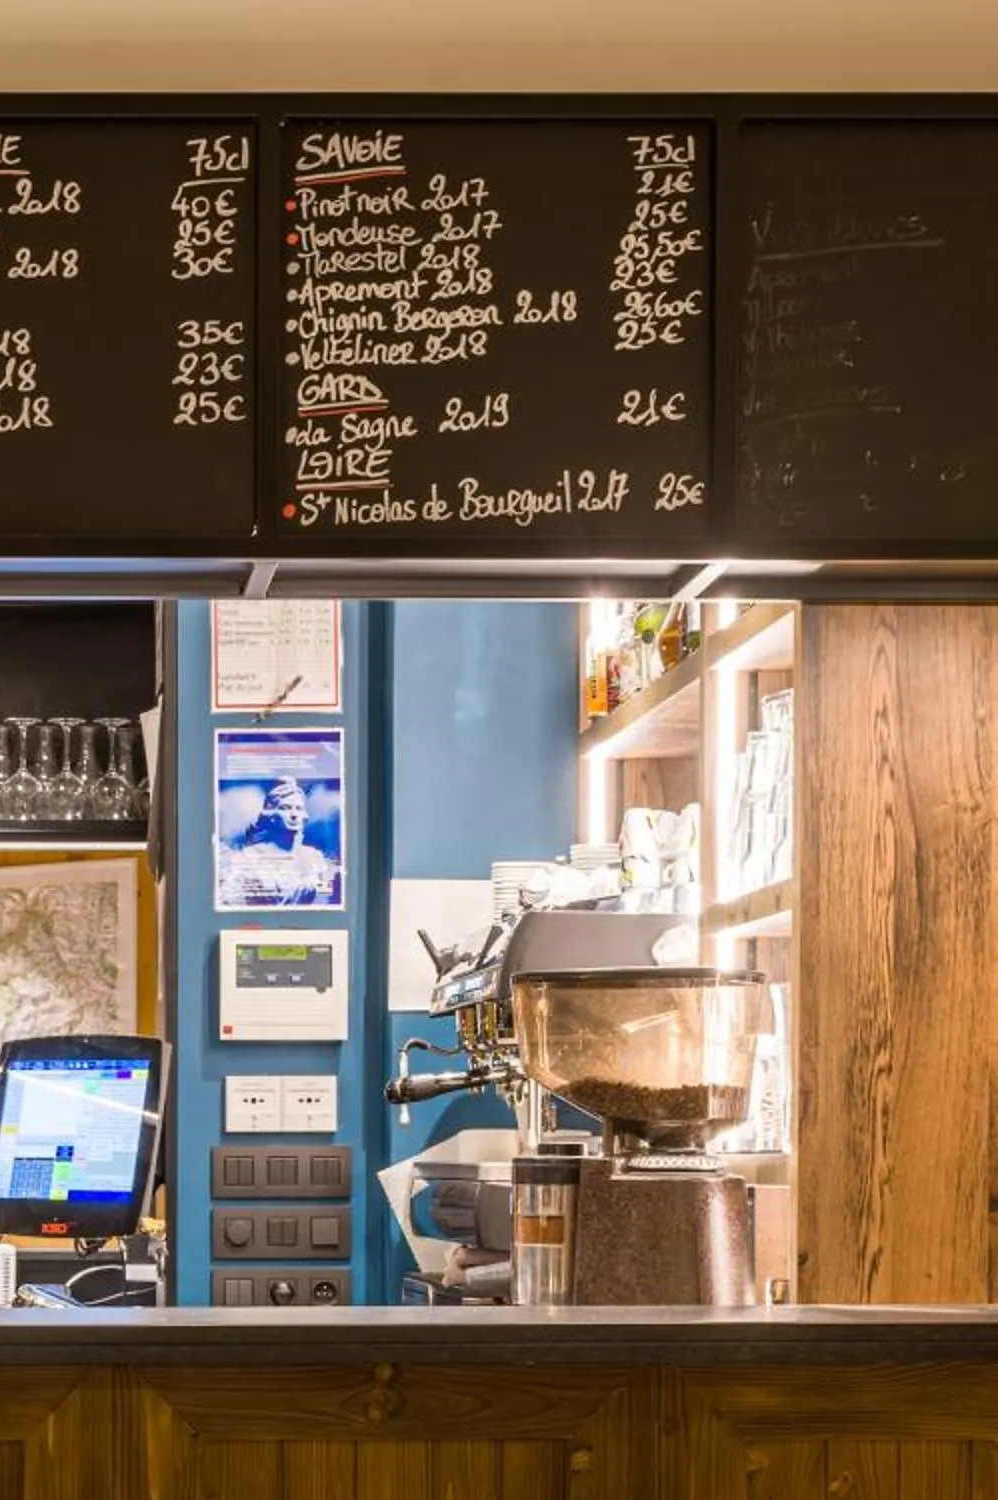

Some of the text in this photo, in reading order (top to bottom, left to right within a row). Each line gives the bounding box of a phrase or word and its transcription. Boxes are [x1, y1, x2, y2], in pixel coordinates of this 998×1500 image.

[186, 135, 249, 176] 75cl
[626, 134, 696, 164] 75cl
[8, 177, 82, 215] 2018
[171, 183, 238, 217] 40€
[295, 184, 358, 220] Pinot
[421, 173, 489, 211] 2017
[636, 170, 695, 197] 21€
[174, 218, 236, 251] 25€
[295, 199, 688, 250] Mondeuse 2017 25€
[8, 247, 80, 279] 2018
[171, 247, 234, 279] 30€
[417, 242, 481, 271] 2018
[431, 268, 493, 300] 2018
[609, 258, 679, 291] 23€
[177, 319, 245, 348] 35€
[298, 306, 387, 344] Chignin
[513, 289, 578, 324] 2018
[420, 330, 488, 364] 2018
[614, 317, 685, 351] 25€
[171, 351, 245, 386] 23€
[297, 372, 383, 405] GARD
[173, 391, 247, 426] 25€
[340, 412, 418, 450] Sagne
[438, 393, 510, 433] 2019
[617, 388, 687, 427] 21€
[335, 489, 417, 525] Nicolas
[422, 483, 454, 521] de
[654, 472, 705, 512] 25€
